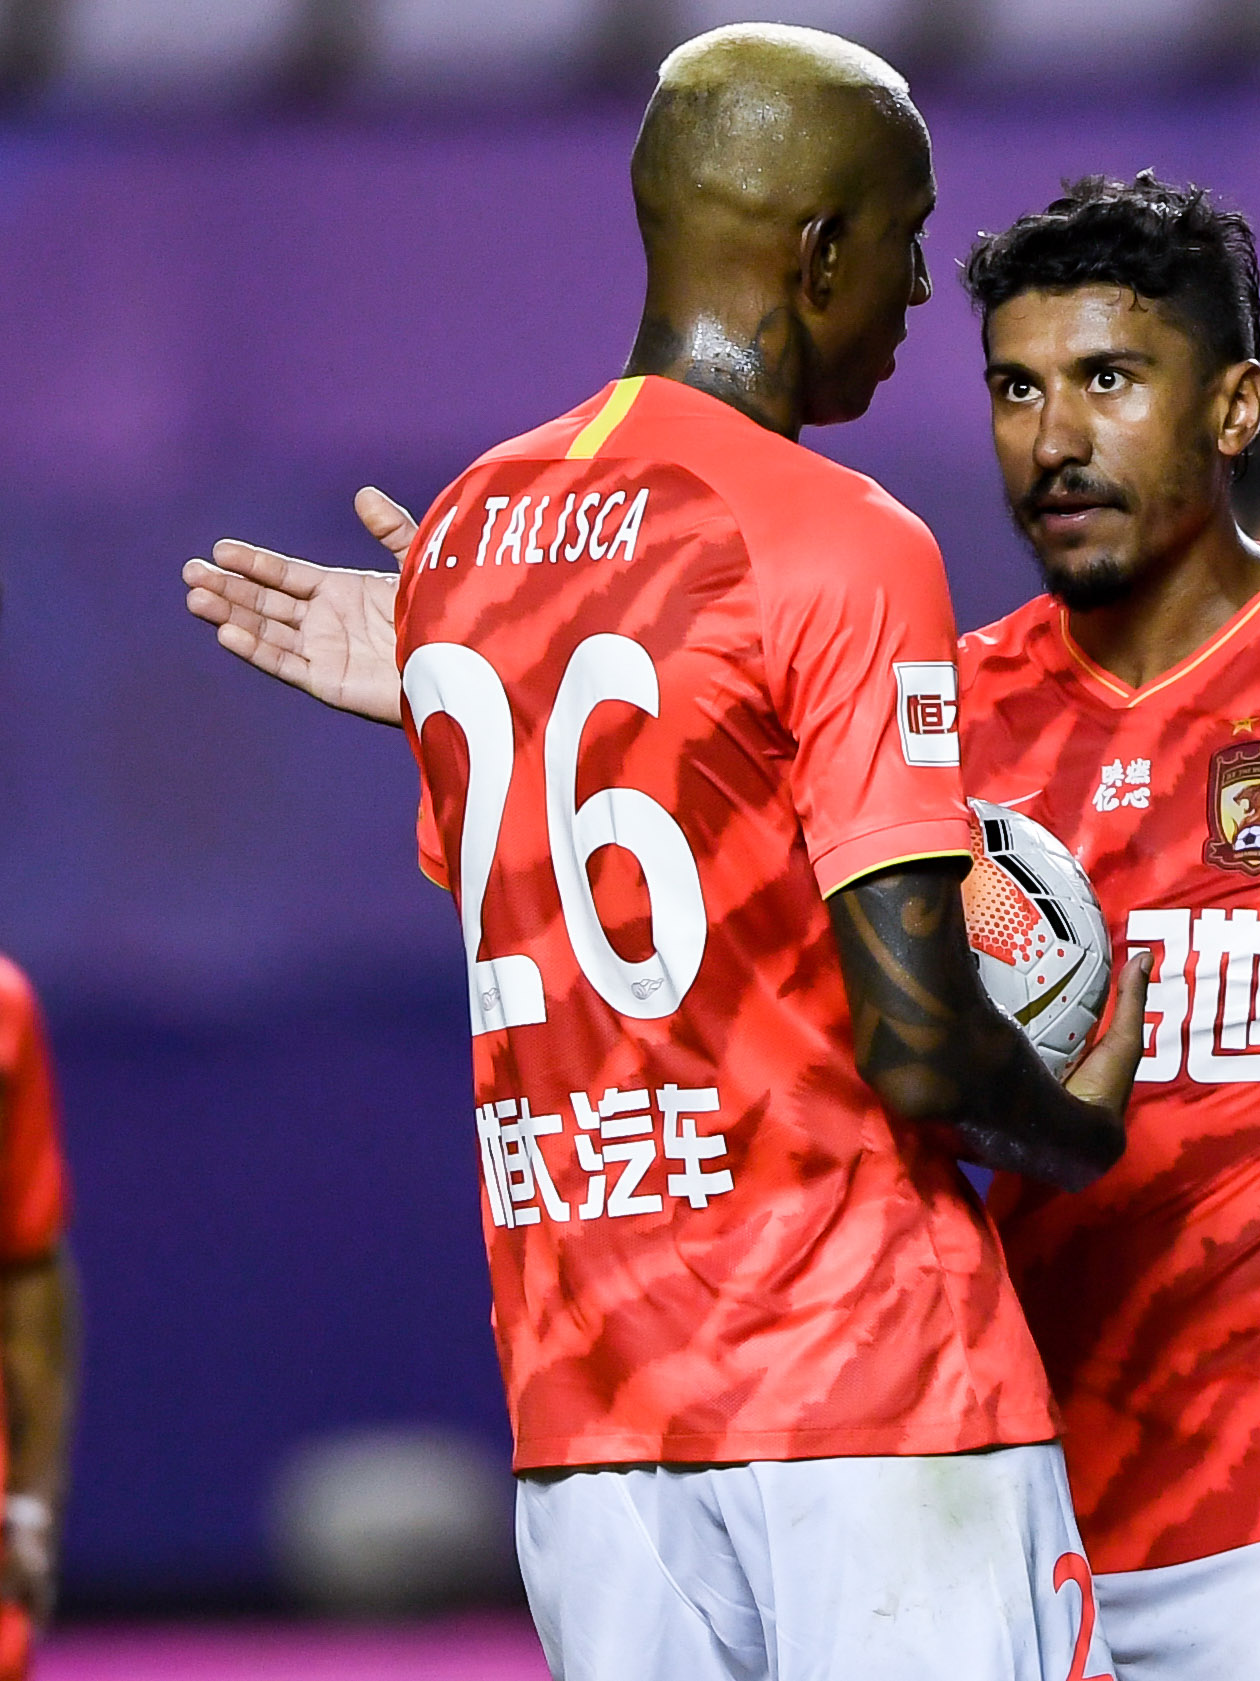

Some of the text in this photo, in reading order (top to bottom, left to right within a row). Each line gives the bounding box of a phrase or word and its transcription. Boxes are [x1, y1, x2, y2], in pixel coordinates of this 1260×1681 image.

[418, 488, 649, 574] A. TALISCA
[402, 633, 707, 1037] 26
[475, 1083, 734, 1229] 恒大汽车
